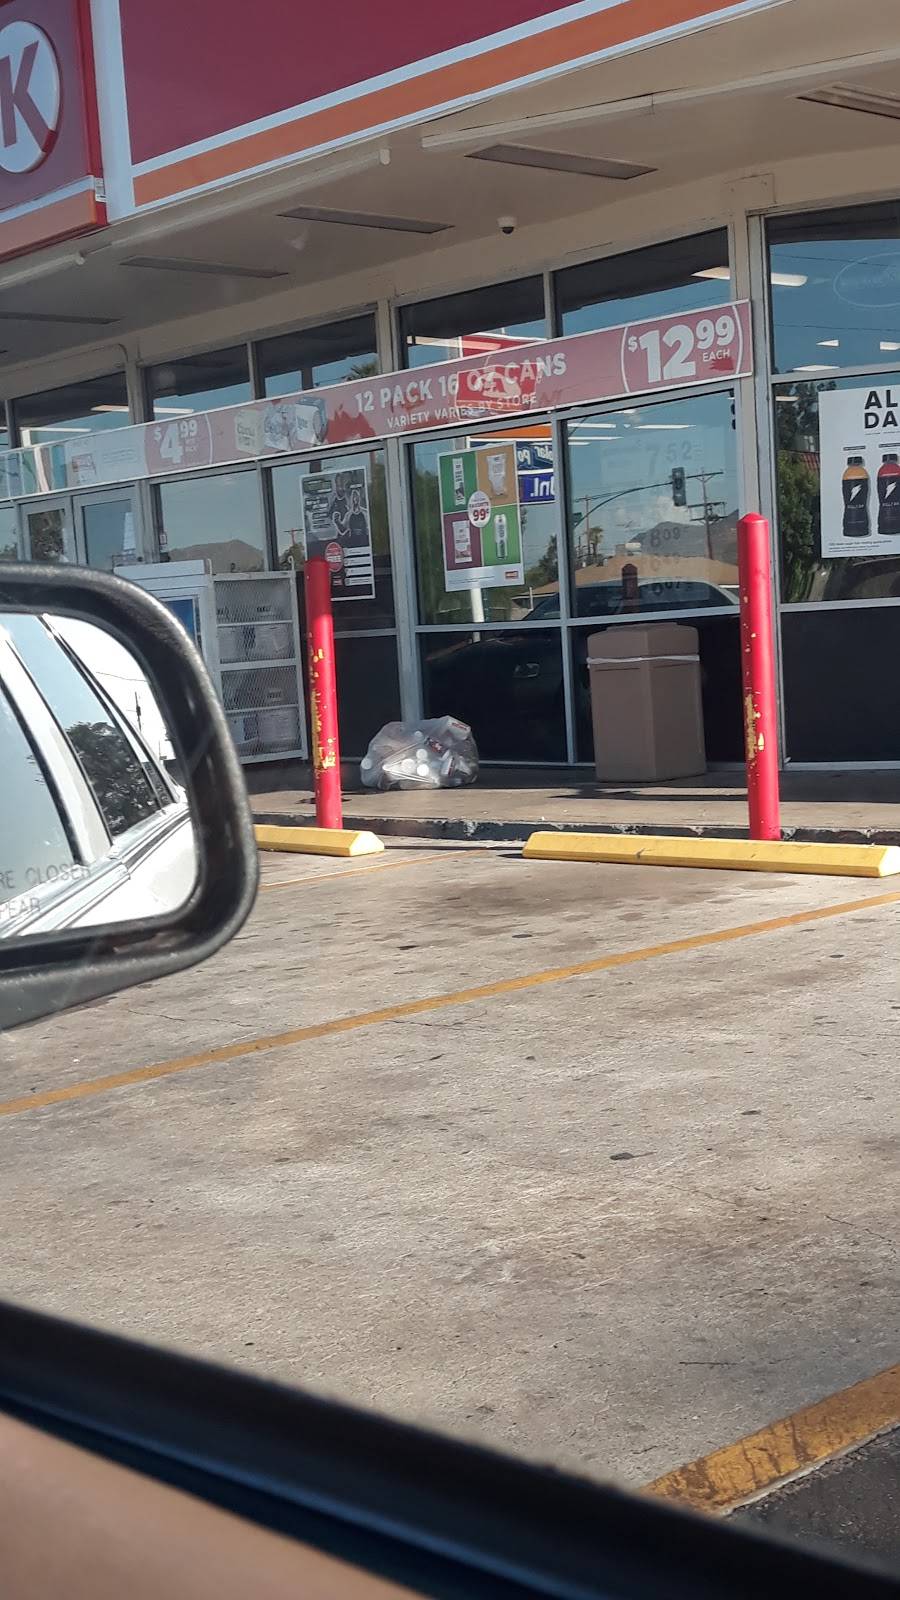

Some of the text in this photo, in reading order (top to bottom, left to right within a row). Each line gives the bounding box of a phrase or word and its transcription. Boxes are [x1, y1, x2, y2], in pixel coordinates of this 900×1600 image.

[0, 40, 54, 151] K
[702, 349, 731, 362] EACH
[354, 390, 375, 413] 12
[380, 378, 433, 409] PACK
[438, 373, 458, 397] 16
[505, 352, 567, 385] CANS
[387, 410, 430, 429] VARIETY
[434, 402, 474, 420] VARIES
[496, 392, 537, 410] STORE
[864, 389, 899, 410] AL
[864, 410, 899, 429] DA
